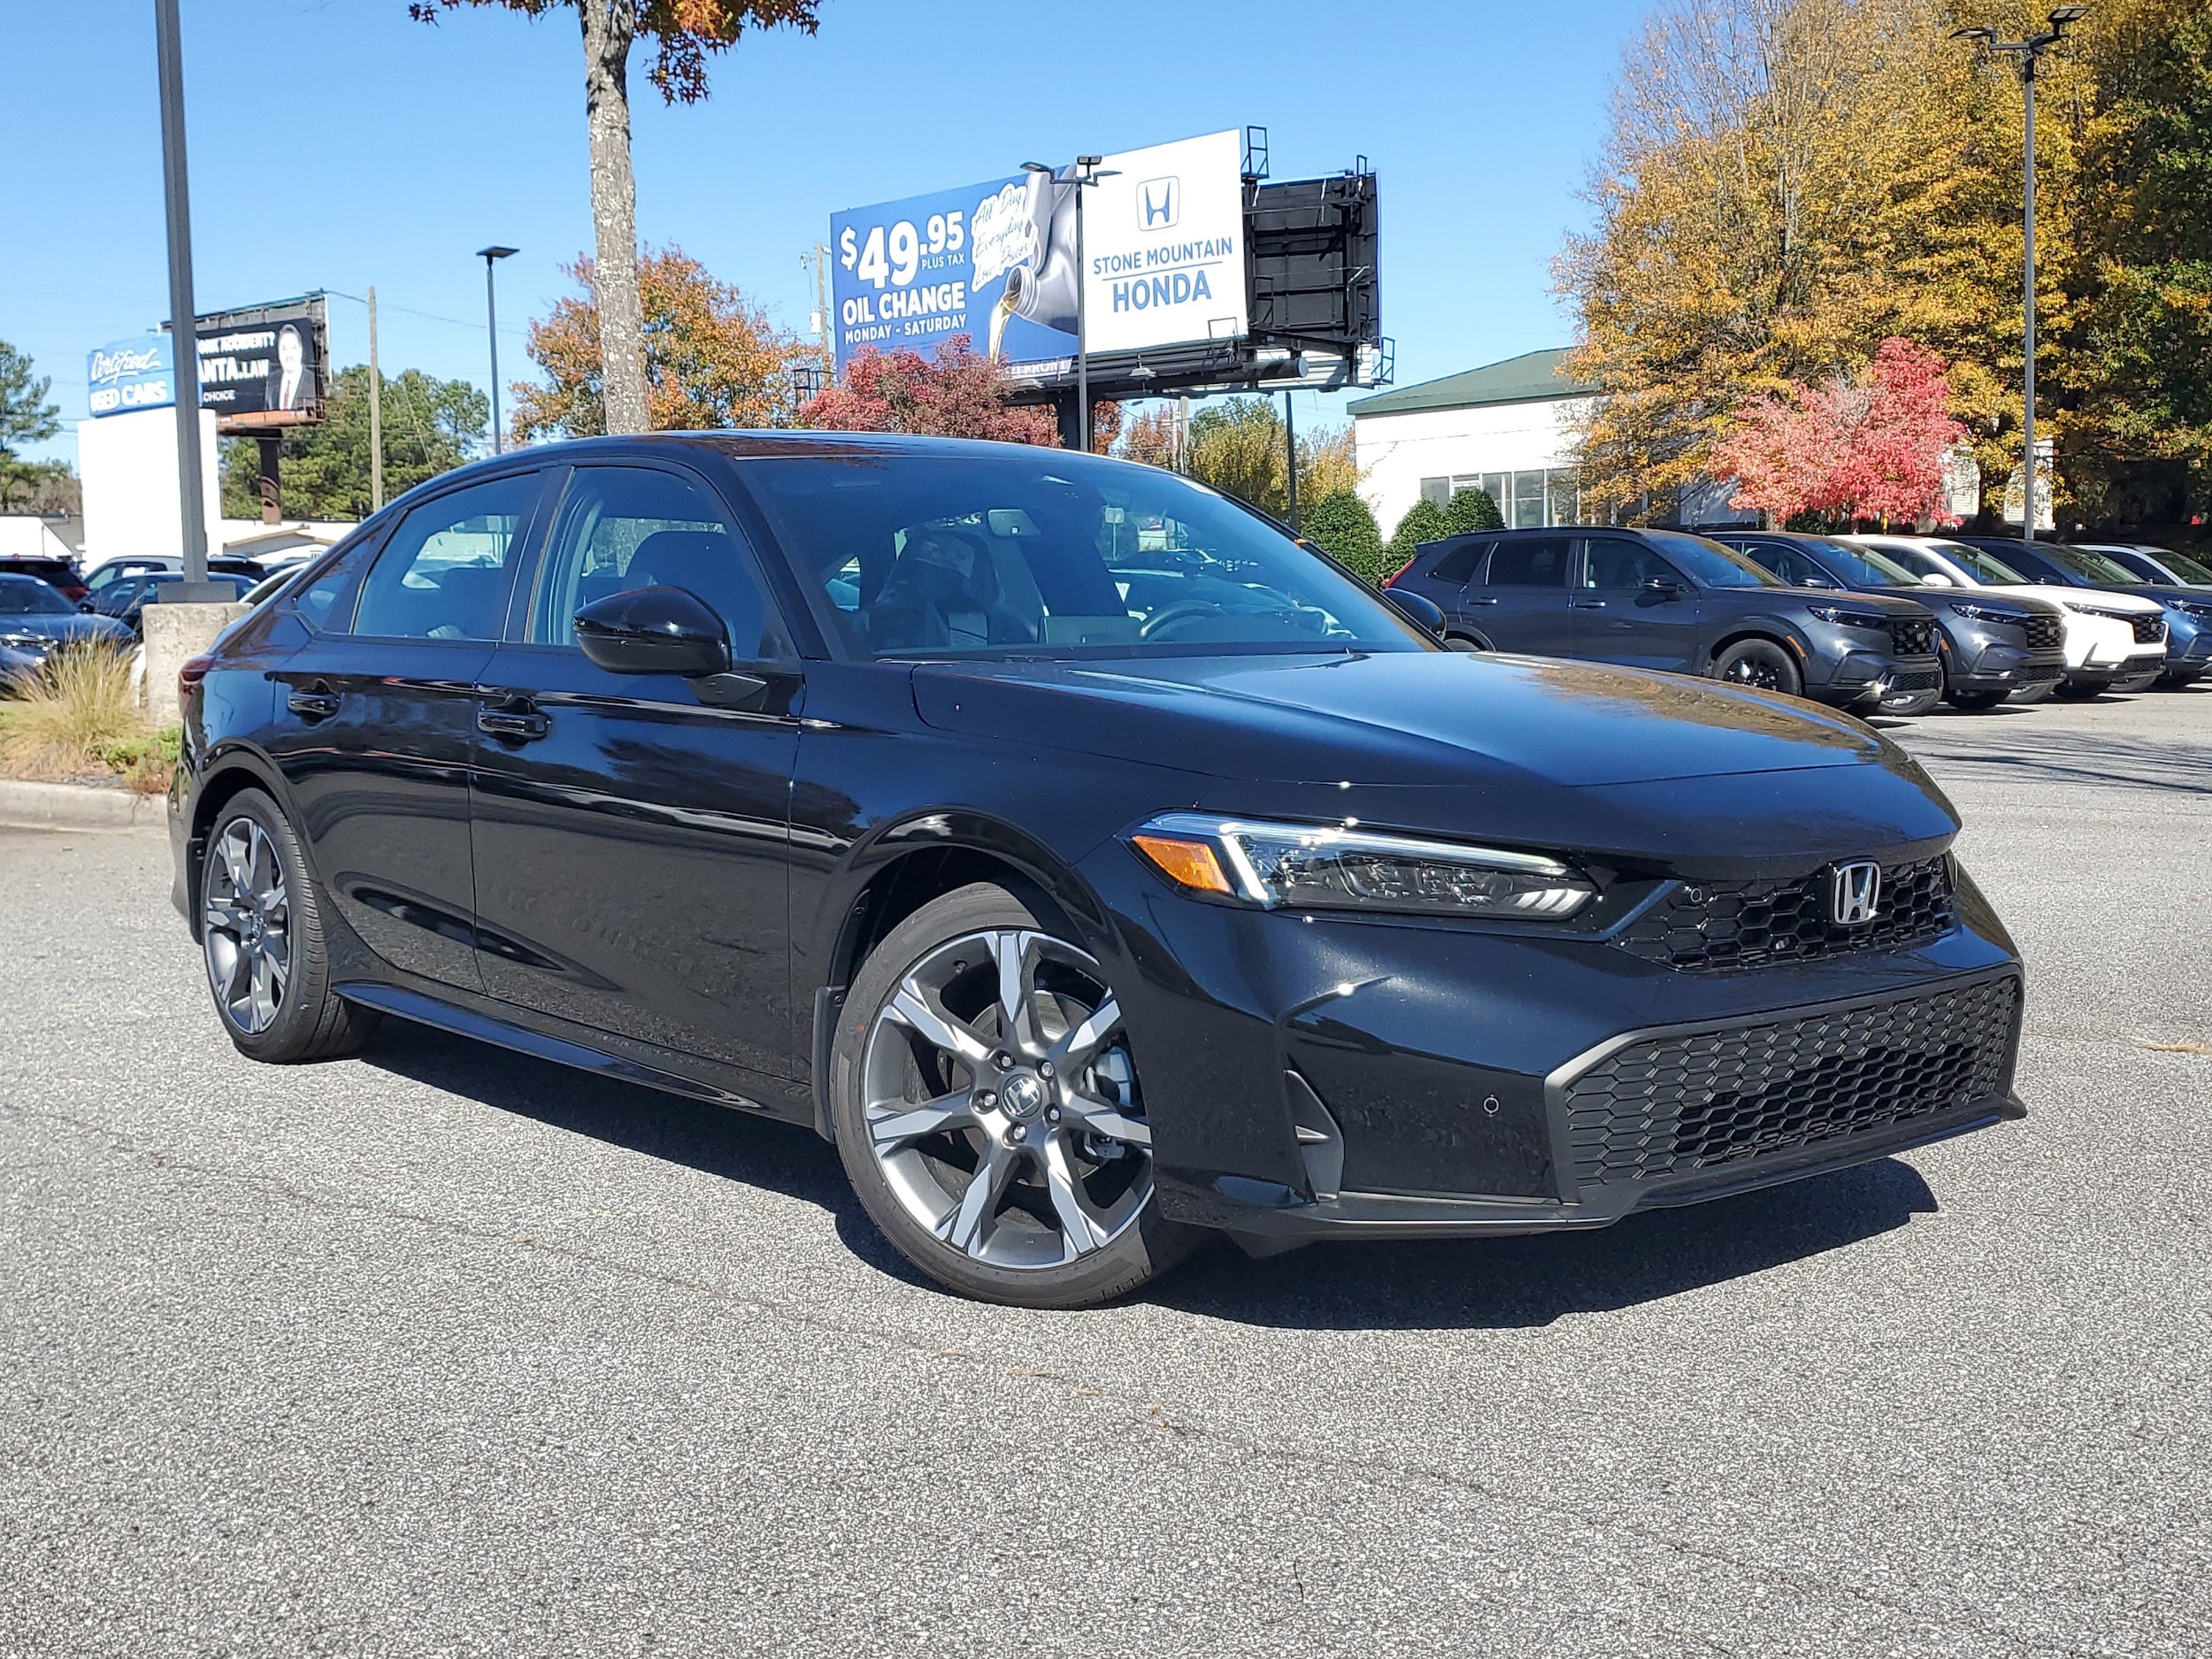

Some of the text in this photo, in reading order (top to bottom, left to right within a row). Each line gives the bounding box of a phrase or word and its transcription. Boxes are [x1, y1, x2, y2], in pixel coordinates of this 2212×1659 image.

[975, 188, 1023, 232] All Day
[975, 216, 1024, 258] Everyday
[1094, 236, 1233, 275] STONE MOUNTAIN
[922, 253, 965, 270] PLUS TAX
[842, 281, 966, 326] OIL CHANGE
[1113, 270, 1212, 312] HONDA
[845, 324, 892, 344] MONDAY
[904, 314, 967, 335] SATURDAY
[91, 348, 162, 385] Certified
[90, 380, 167, 412] USED CARS
[204, 389, 235, 403] CHOICE
